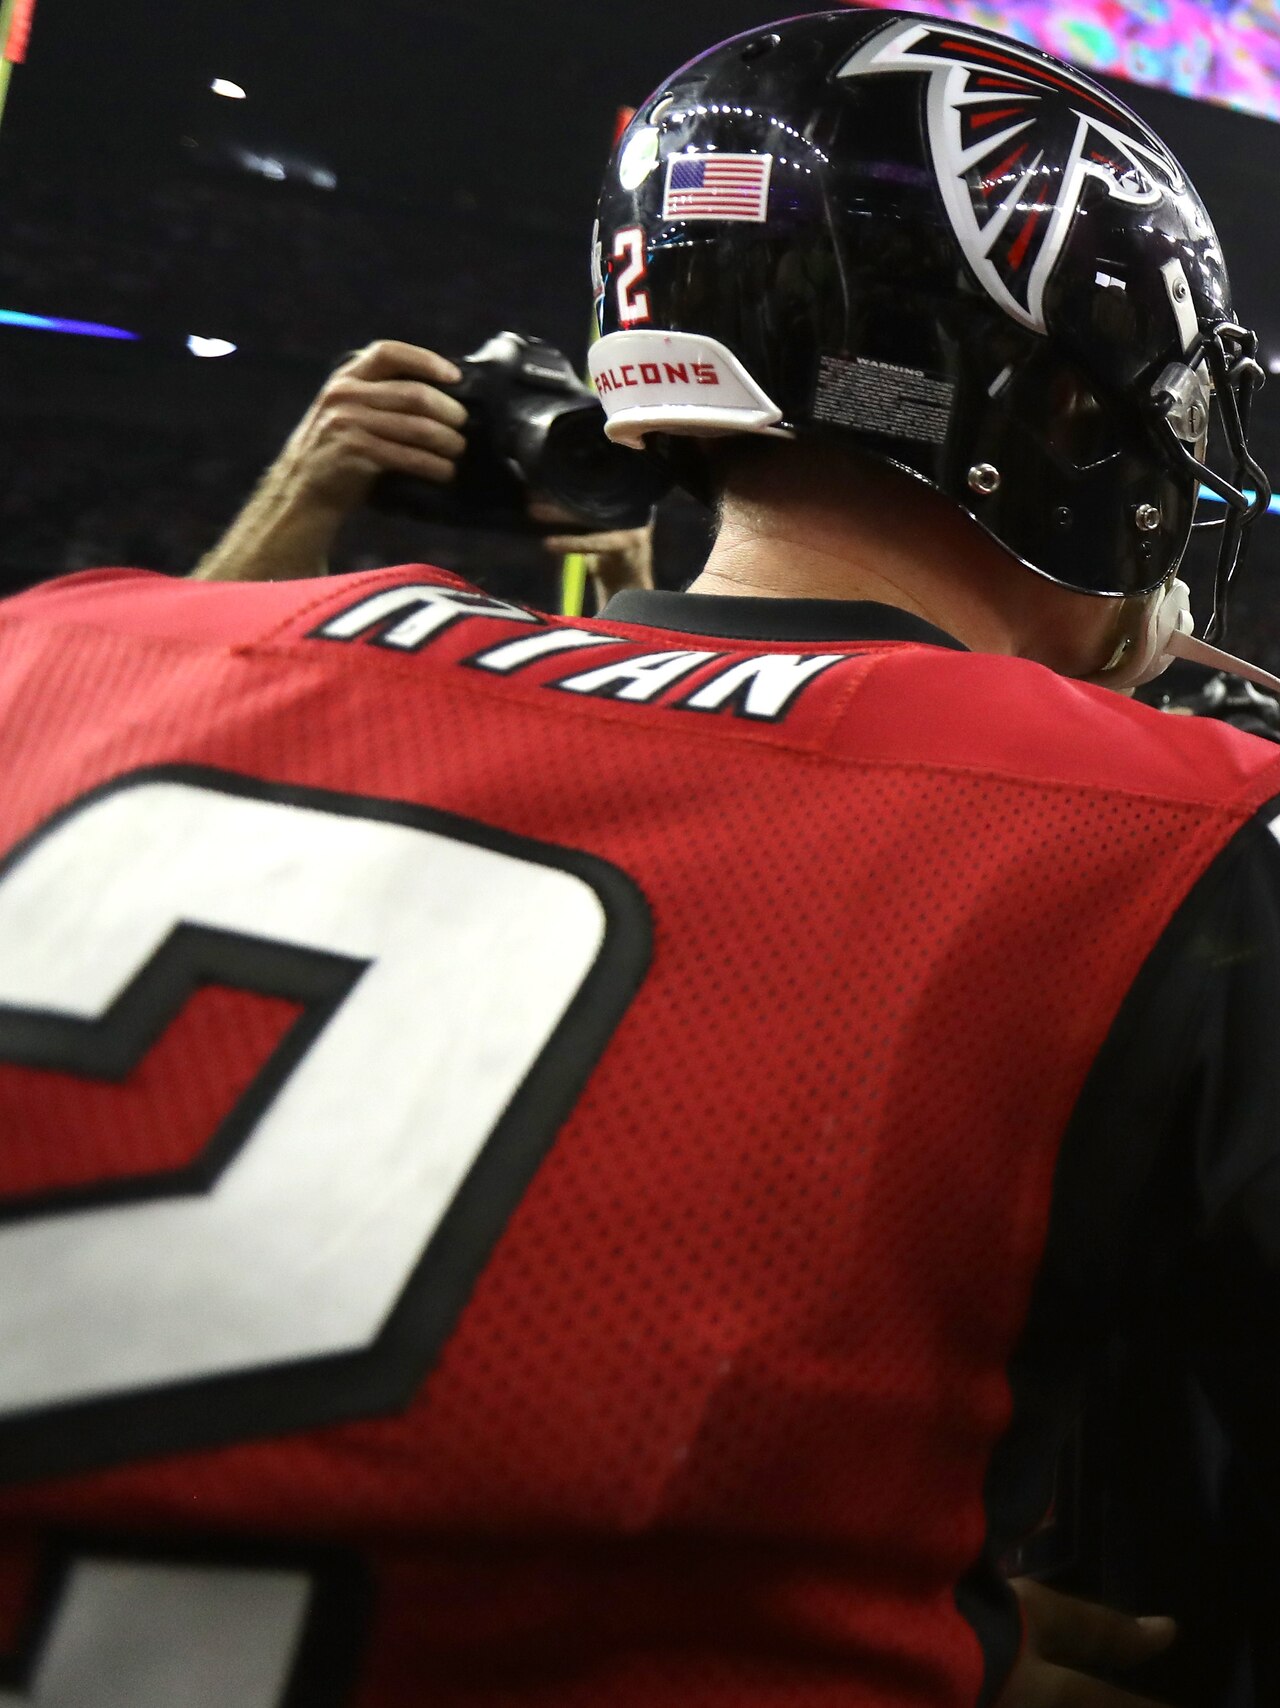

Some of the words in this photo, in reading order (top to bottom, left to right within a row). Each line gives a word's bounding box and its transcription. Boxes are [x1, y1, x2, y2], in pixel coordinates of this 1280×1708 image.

[611, 224, 653, 330] 2
[595, 362, 720, 397] FALCONS
[856, 356, 925, 377] WARNING
[305, 583, 862, 724] RYAN
